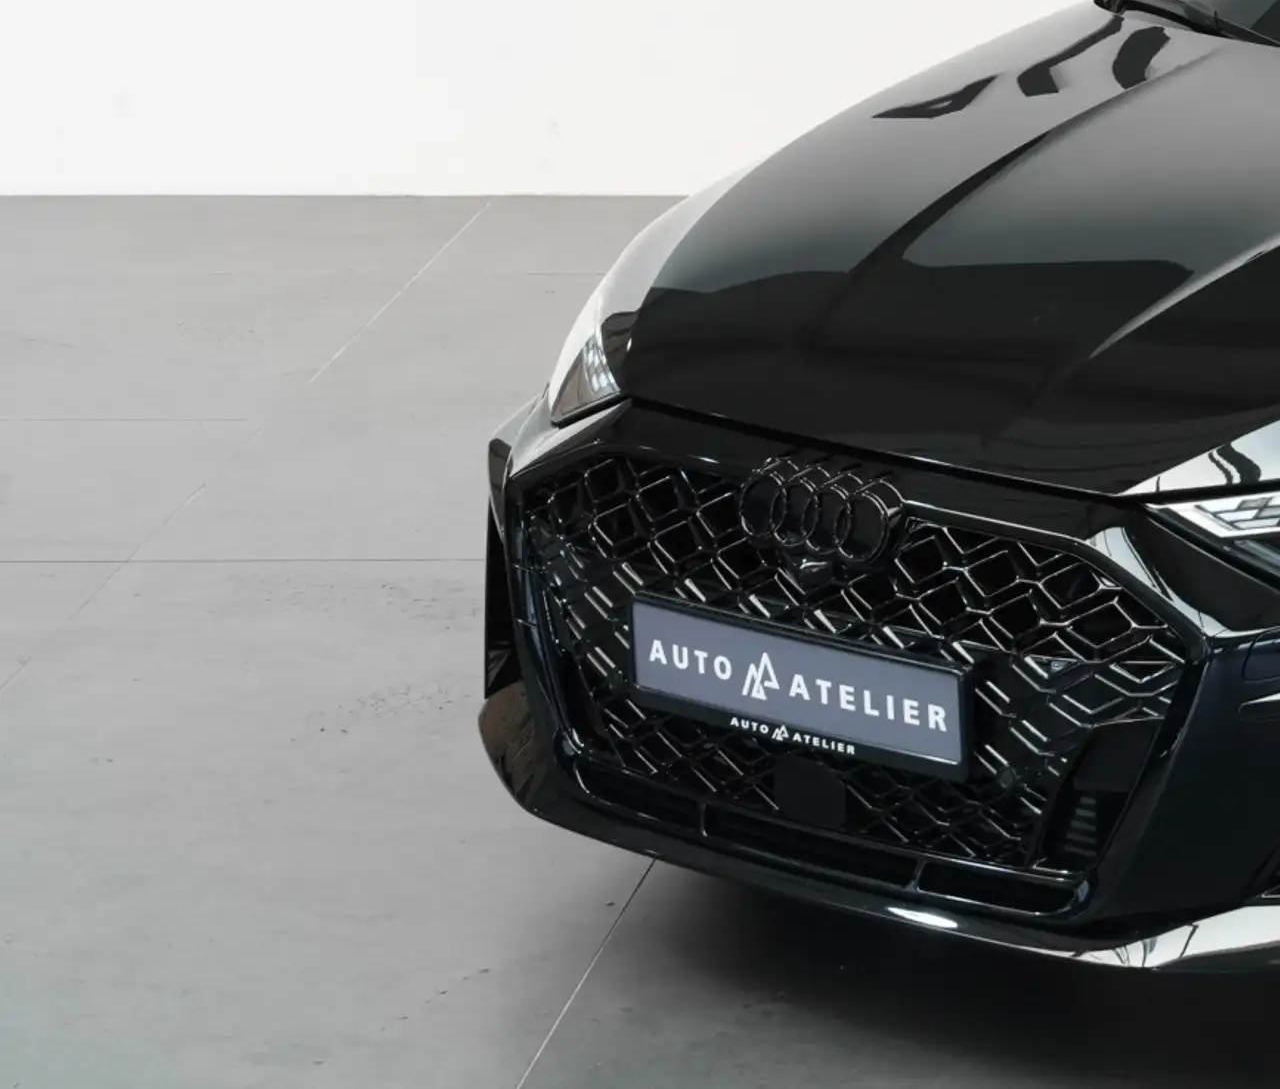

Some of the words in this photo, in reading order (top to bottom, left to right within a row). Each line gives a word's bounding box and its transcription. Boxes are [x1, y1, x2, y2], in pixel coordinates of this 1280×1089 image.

[649, 639, 732, 680] AUTO
[788, 673, 947, 733] ATELIER
[729, 716, 769, 735] AUTO
[792, 732, 856, 756] ATELIER
